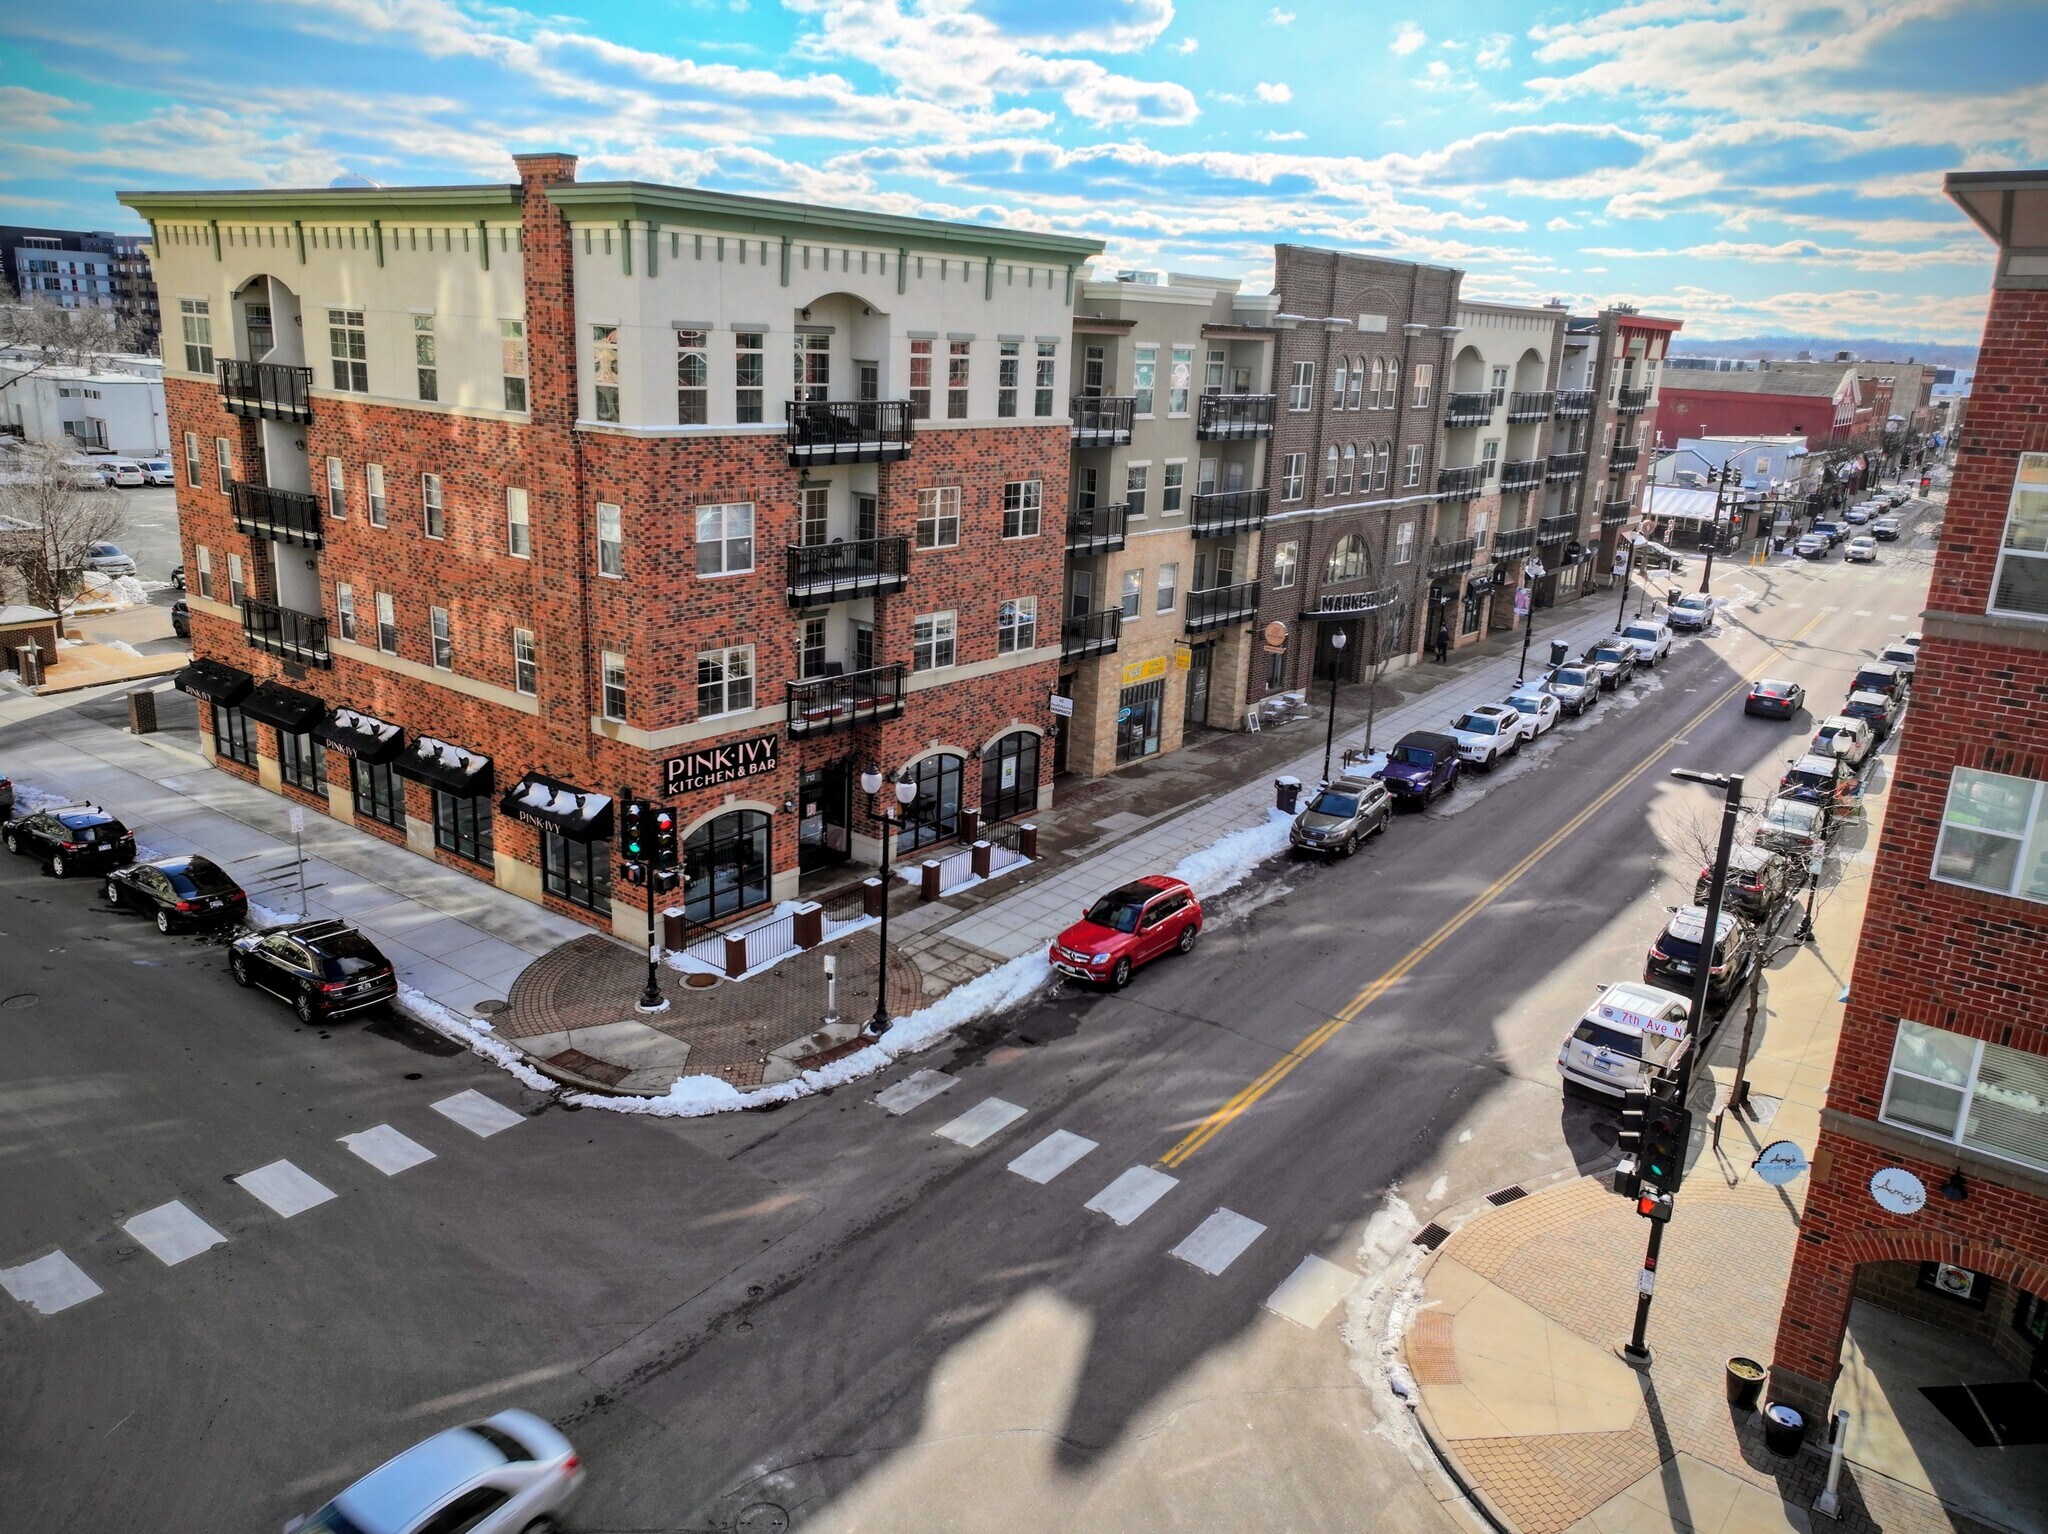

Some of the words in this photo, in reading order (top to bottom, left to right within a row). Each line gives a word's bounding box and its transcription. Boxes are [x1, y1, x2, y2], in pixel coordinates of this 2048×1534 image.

[668, 768, 735, 795] KITCHEN
[737, 765, 746, 777] &
[749, 758, 776, 774] BAR
[1622, 1011, 1640, 1026] 7th
[1646, 1019, 1667, 1034] Ave
[1674, 1026, 1683, 1038] N
[1769, 1153, 1797, 1167] Amy's
[1873, 1178, 1923, 1206] Amy's
